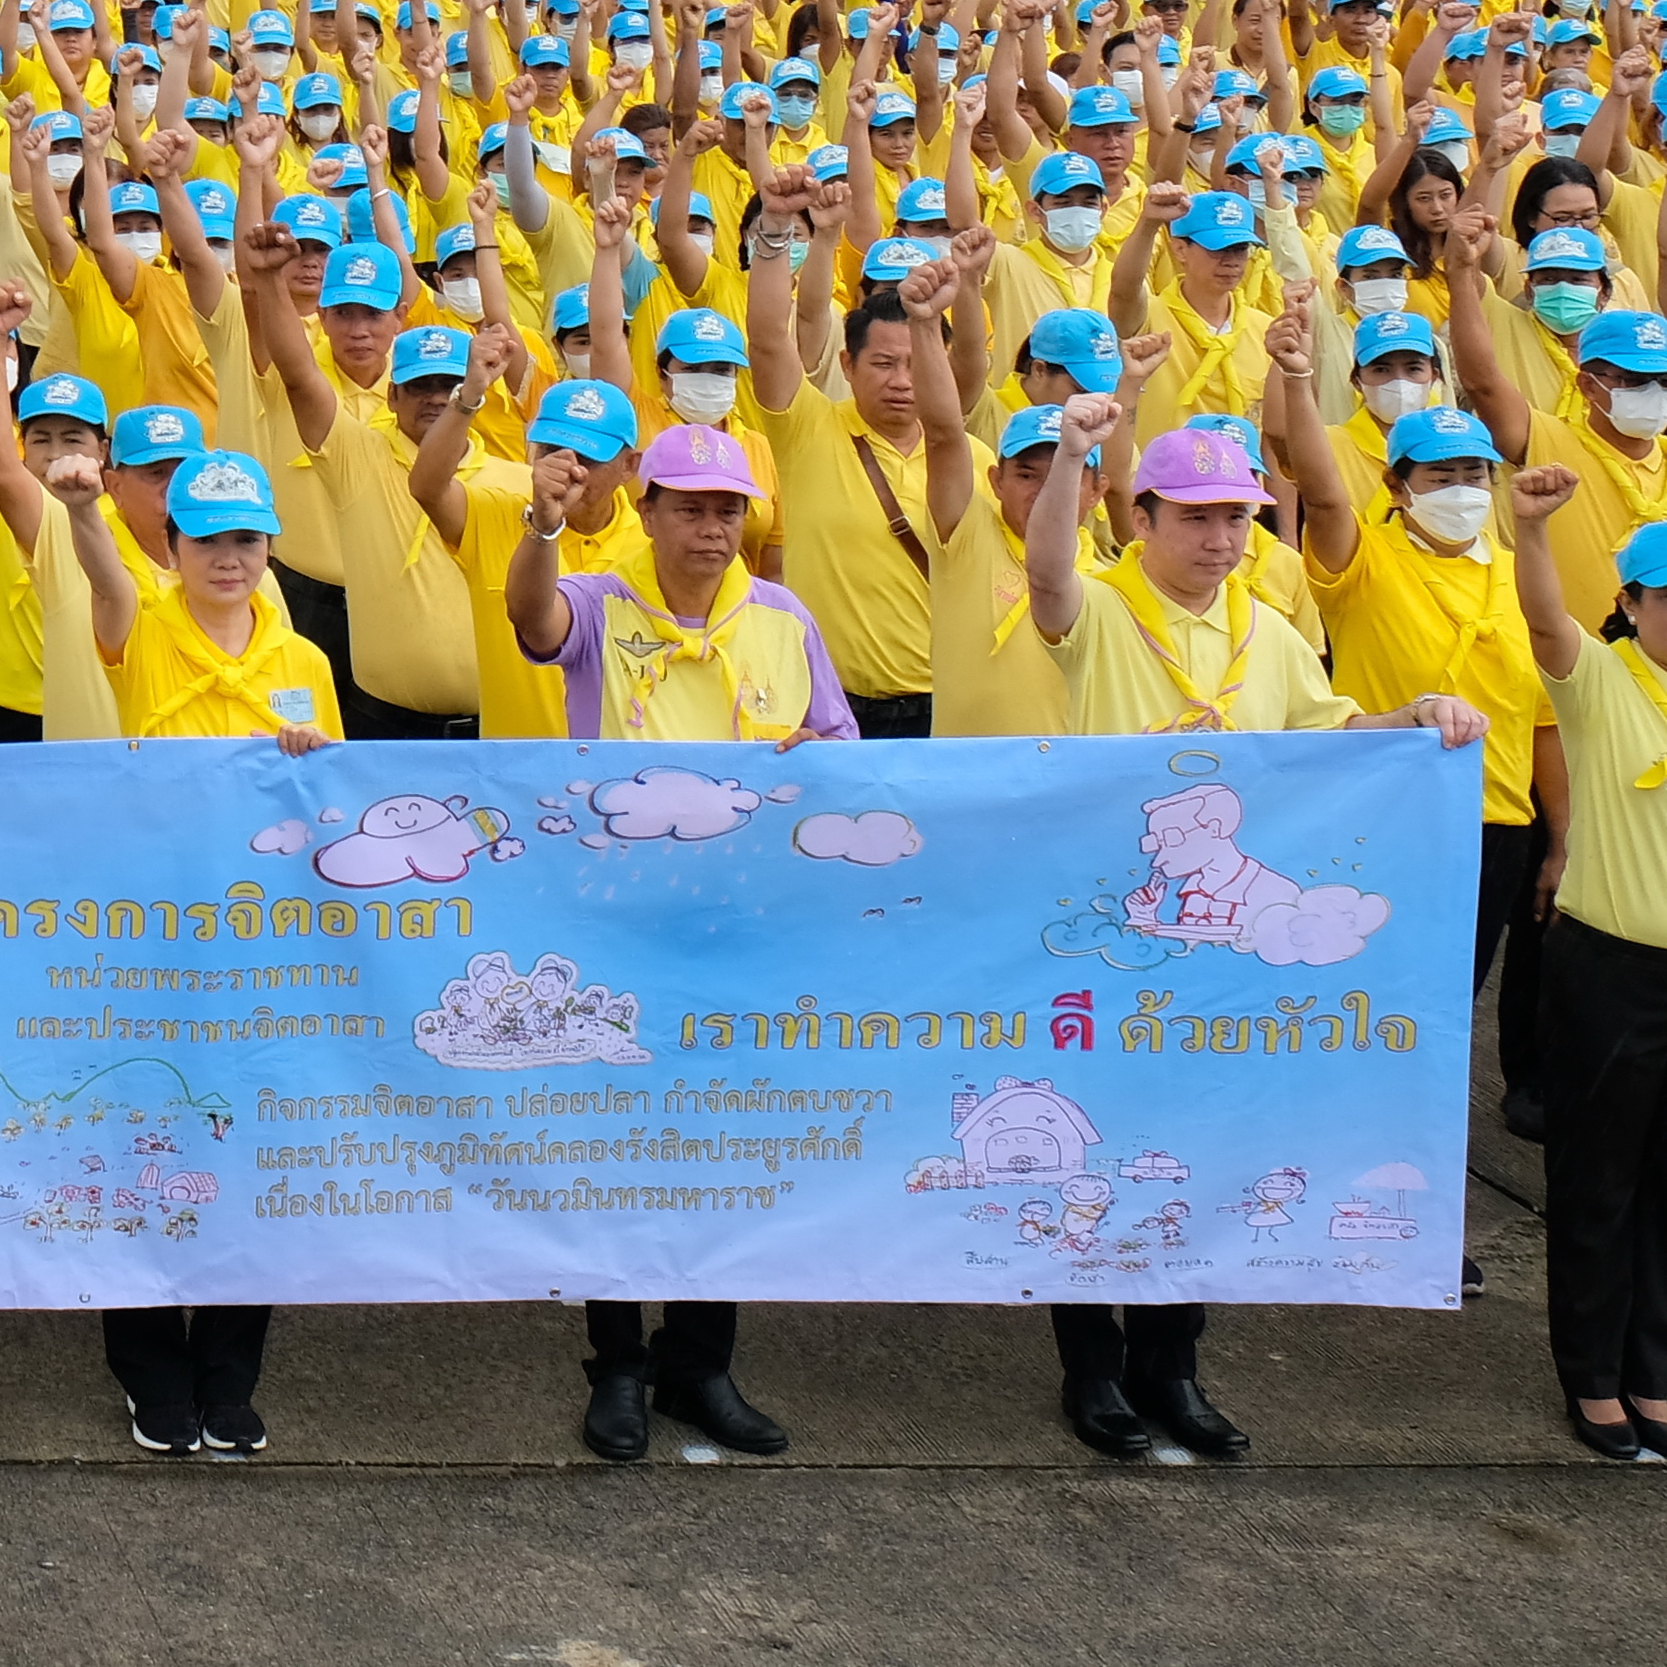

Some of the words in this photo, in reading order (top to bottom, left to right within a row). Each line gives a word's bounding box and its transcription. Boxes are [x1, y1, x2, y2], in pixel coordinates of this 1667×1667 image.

[45, 954, 361, 993] หน่วยพระราชทาน
[14, 1005, 386, 1044] และประชาชนจิตอาสา
[680, 994, 1027, 1051] เราทำความ
[1049, 990, 1095, 1052] ดี
[1122, 989, 1419, 1055] ด้วยหัวใจ
[256, 1085, 494, 1124] กิจกรรมจิตอาสา
[505, 1082, 652, 1122] ปล่อยปลา
[663, 1077, 893, 1116] กำจัดผักตบชวา
[255, 1116, 864, 1184] และปรับปรุงภูมิทัศน์คลองรังสิตประยูรศักดิ์
[254, 1179, 453, 1221] เนื่องในโอกาส
[469, 1174, 796, 1218] “วันนวมินทรมหาราช”
